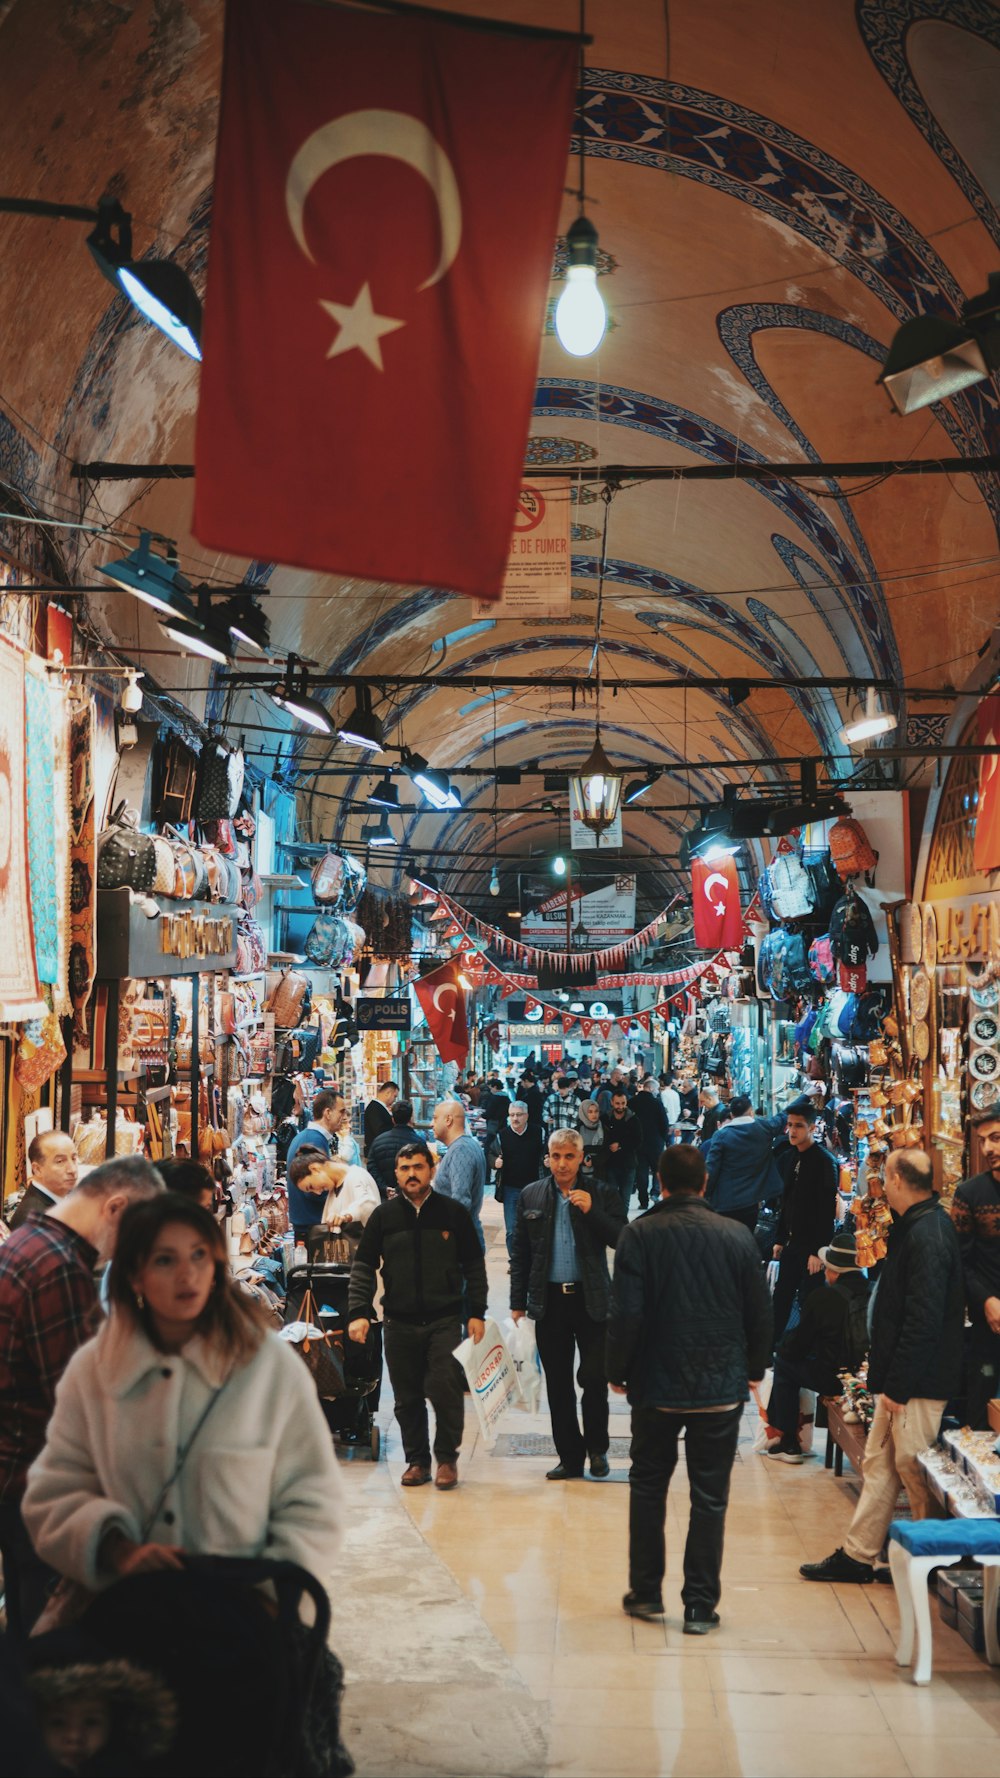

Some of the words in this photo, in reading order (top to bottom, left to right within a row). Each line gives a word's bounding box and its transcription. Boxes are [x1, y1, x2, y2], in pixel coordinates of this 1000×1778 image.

[520, 538, 532, 554] DE
[535, 538, 567, 554] FUMER
[374, 1002, 409, 1015] POLİS
